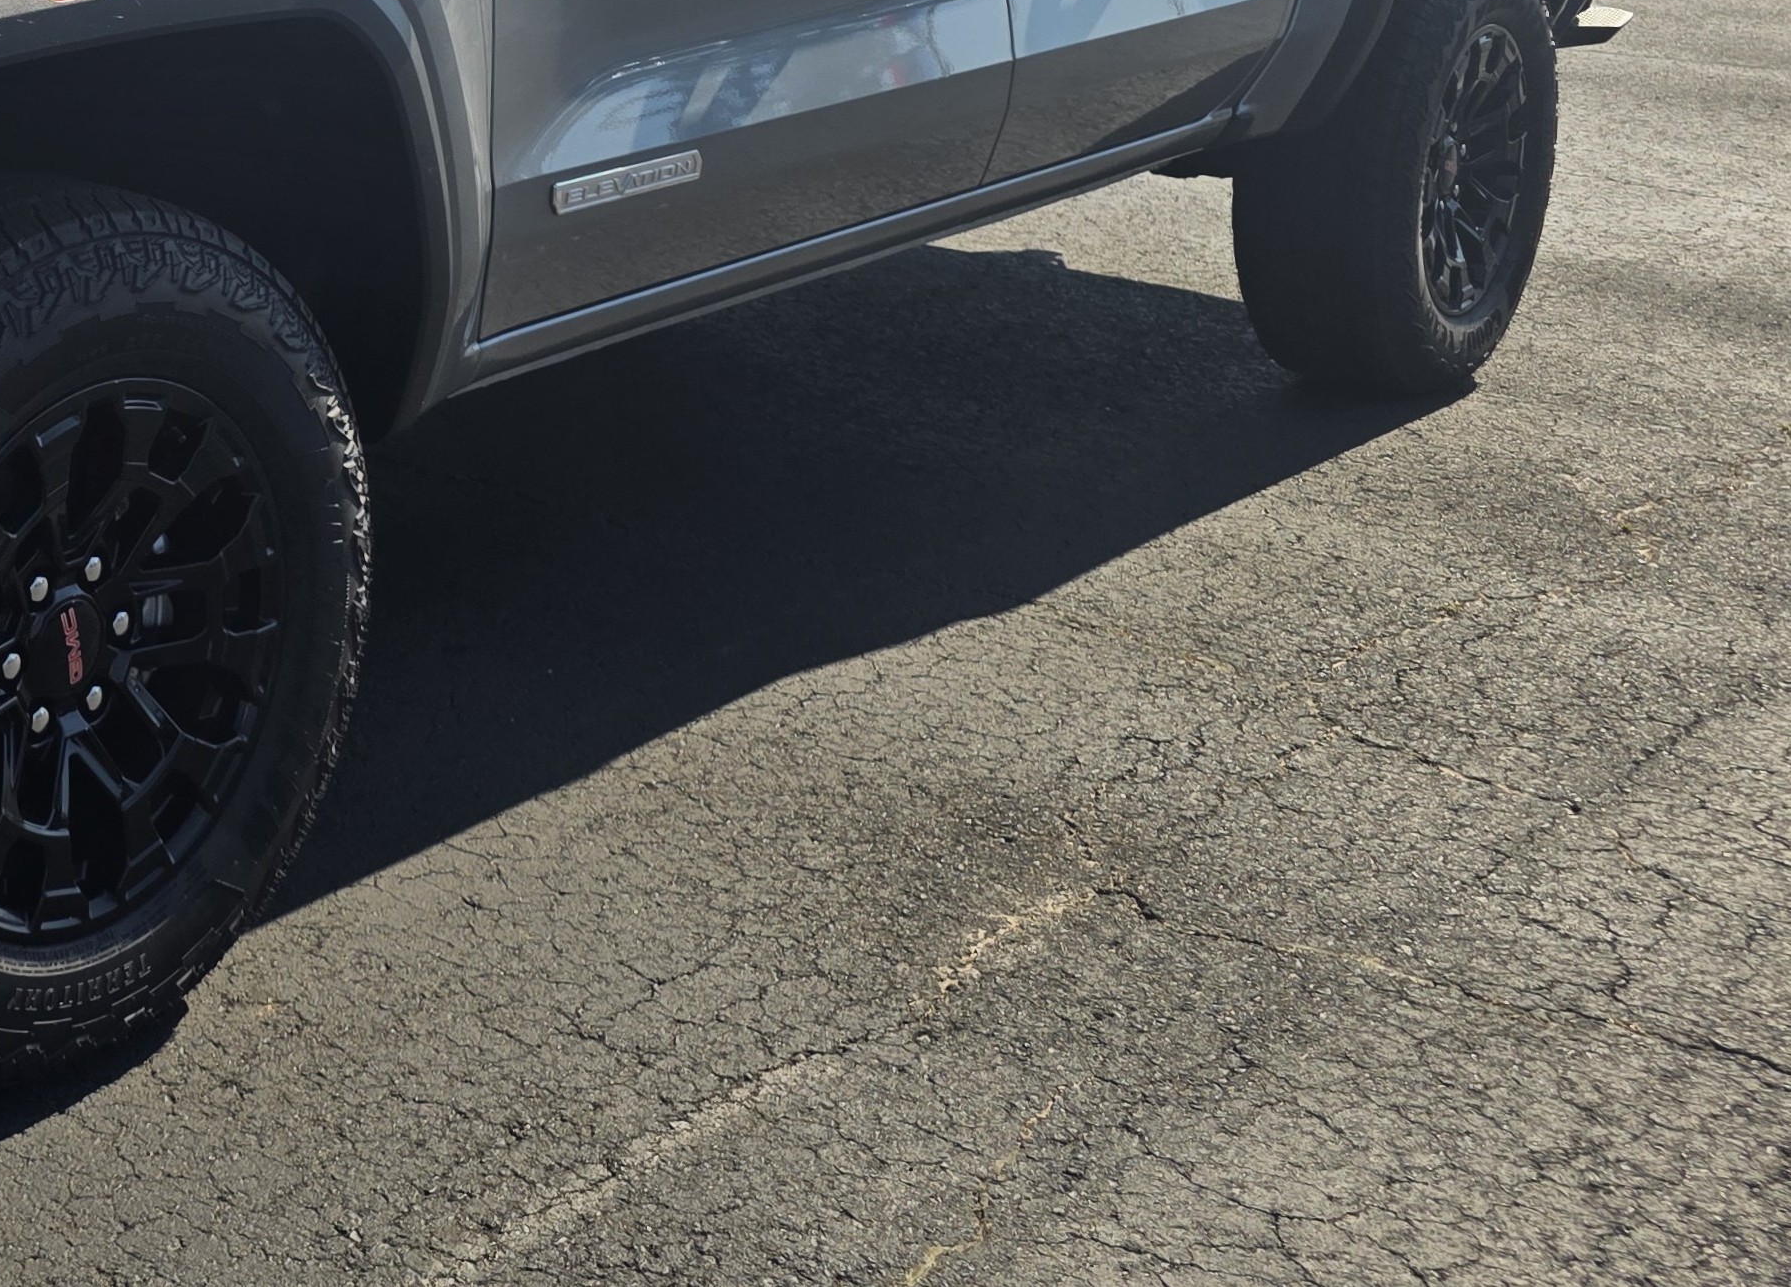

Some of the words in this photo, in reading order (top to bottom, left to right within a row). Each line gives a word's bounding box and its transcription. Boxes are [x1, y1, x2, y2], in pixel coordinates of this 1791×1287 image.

[565, 159, 694, 206] ELEVATION
[60, 607, 84, 685] GMC
[7, 953, 152, 1011] TERRITORY
